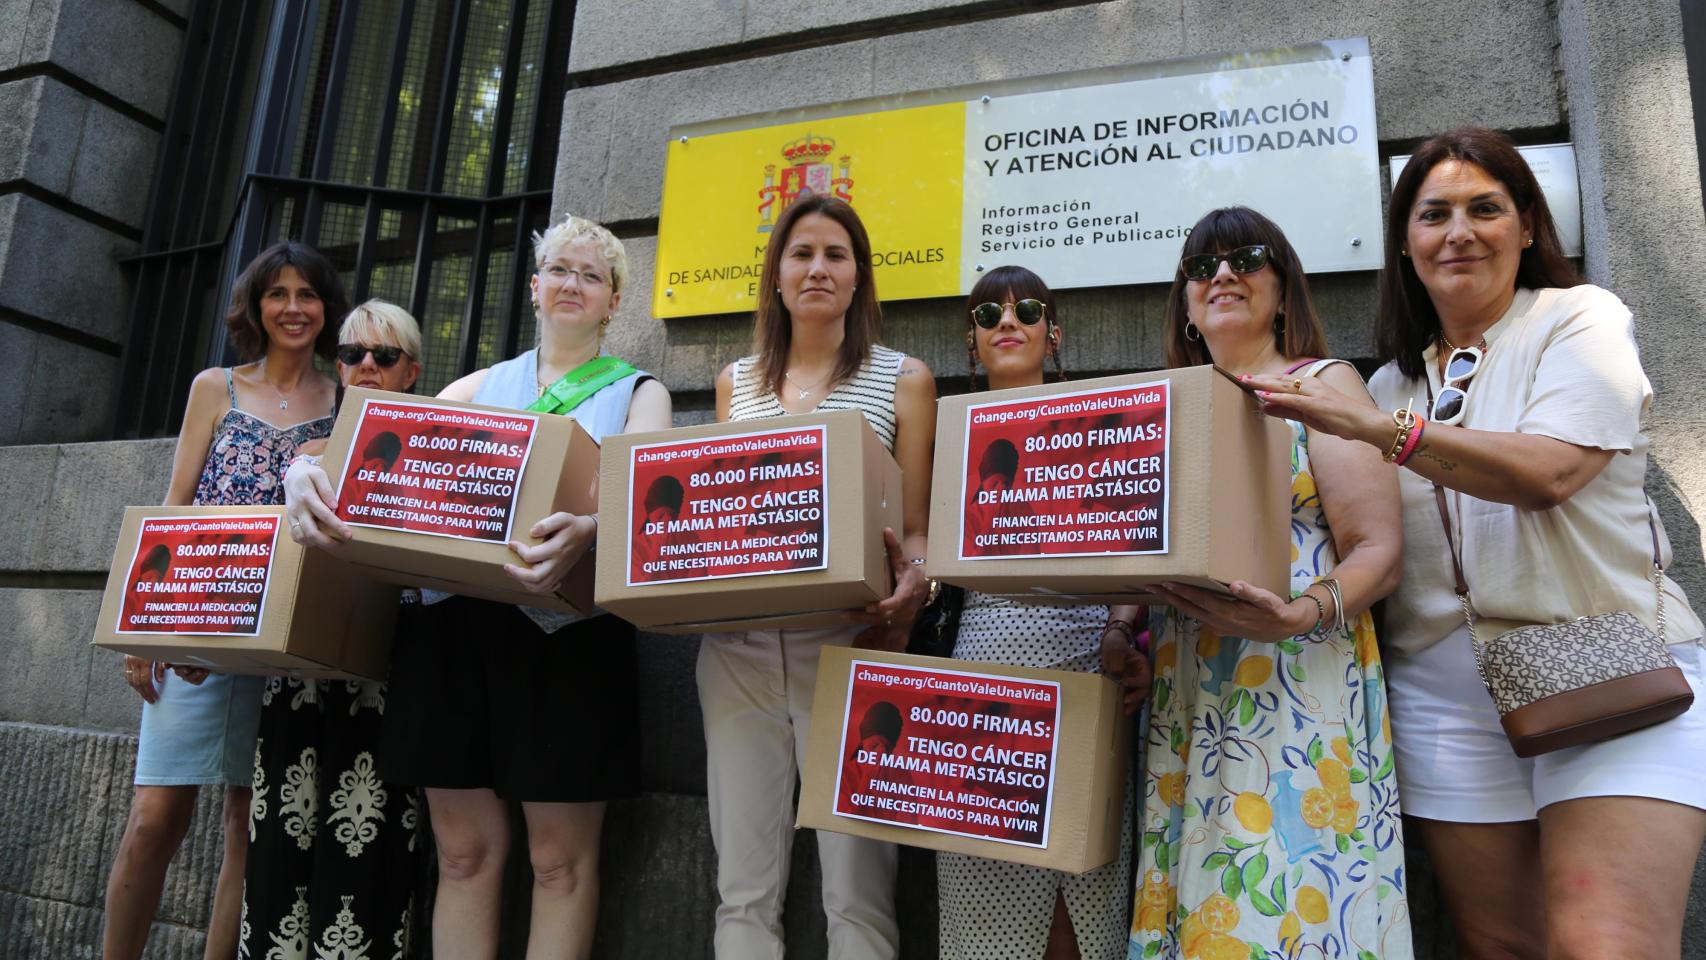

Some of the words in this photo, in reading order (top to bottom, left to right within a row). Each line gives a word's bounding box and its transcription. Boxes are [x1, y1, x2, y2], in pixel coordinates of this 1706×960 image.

[985, 126, 1085, 151] OFICINA
[1094, 121, 1127, 141] DE
[1137, 99, 1328, 136] INFORMACIÓN
[984, 159, 999, 176] Y
[1007, 144, 1138, 175] ATENCIÓN
[1147, 142, 1181, 162] AL
[1190, 125, 1358, 157] CIUDADANO
[982, 199, 1091, 219] Información
[982, 219, 1058, 236] Registro
[1067, 212, 1139, 229] General
[982, 236, 1055, 252] Servicio
[1064, 234, 1084, 247] de
[1093, 226, 1192, 244] Publicacio
[669, 271, 689, 284] DE
[871, 248, 944, 267] OCIALES
[369, 406, 528, 432] change.org/CuantoValeUnaVida
[974, 392, 1160, 423] change.org/CuantoValeUnaVida
[409, 435, 457, 451] 80.000
[460, 440, 523, 457] FIRMAS:
[638, 435, 816, 462] change.org/CuantoValeUnaVida
[1025, 433, 1083, 452] 80.000
[1087, 424, 1162, 446] FIRMAS:
[404, 459, 453, 476] TENGO
[456, 463, 515, 481] CÁNCER
[690, 470, 745, 487] 80.000
[750, 461, 819, 481] FIRMAS:
[1024, 463, 1083, 483] TENGO
[1088, 457, 1160, 477] CÁNCER
[358, 470, 374, 481] DE
[377, 472, 420, 487] MAMA
[423, 478, 512, 497] METASTÁSICO
[979, 491, 997, 504] DE
[1001, 487, 1048, 503] MAMA
[1052, 478, 1161, 500] METASTÁSICO
[366, 493, 421, 508] FINANCIEN
[424, 500, 436, 510] LA
[439, 502, 505, 517] MEDICACIÓN
[690, 496, 746, 514] TENGO
[751, 490, 819, 507] CÁNCER
[146, 522, 272, 533] change.org/CuantoValeUnaVida
[348, 505, 369, 516] QUE
[371, 507, 442, 525] NECESITAMOS
[445, 517, 472, 528] PARA
[475, 520, 502, 531] VIVIR
[646, 522, 664, 535] DE
[668, 518, 714, 533] MAMA
[718, 508, 820, 529] METASTÁSICO
[992, 515, 1055, 528] FINANCIEN
[1059, 514, 1073, 525] LA
[1077, 507, 1157, 524] MEDICACIÓN
[660, 542, 721, 555] FINANCIEN
[724, 540, 738, 550] LA
[741, 532, 817, 549] MEDICACIÓN
[976, 535, 998, 546] QUE
[1001, 531, 1084, 545] NECESITAMOS
[1087, 530, 1120, 541] PARA
[1124, 527, 1157, 539] VIVIR
[177, 545, 217, 556] 80.000
[219, 544, 270, 556] FIRMAS:
[644, 561, 667, 573] QUE
[669, 554, 749, 570] NECESITAMOS
[752, 551, 783, 562] PARA
[786, 549, 817, 560] VIVIR
[174, 568, 212, 578] TENGO
[215, 565, 265, 578] CÁNCER
[137, 582, 152, 592] DE
[154, 582, 187, 592] MAMA
[189, 580, 262, 593] METASTÁSICO
[130, 615, 147, 624] QUE
[149, 615, 204, 623] NECESITAMOS
[206, 616, 228, 624] PARA
[230, 616, 254, 625] VIVIR
[145, 603, 188, 611] FINANCIEN
[189, 603, 199, 611] LA
[201, 602, 256, 612] MEDICACIÓN
[858, 670, 1050, 701] change.org/CuantoValeUnaVida
[910, 707, 968, 727] 80.000
[973, 714, 1050, 738] FIRMAS:
[908, 737, 967, 757] TENGO
[971, 743, 1047, 769] CÁNCER
[857, 750, 876, 764] DE
[880, 754, 930, 773] MAMA
[935, 762, 1045, 789] METASTÁSICO
[870, 779, 936, 799] FINANCIEN
[939, 791, 954, 802] LA
[957, 793, 1039, 815] MEDICACIÓN
[851, 793, 874, 806] QUE
[877, 796, 964, 821] NECESITAMOS
[967, 812, 999, 826] PARA
[1003, 817, 1038, 832] VIVIR
